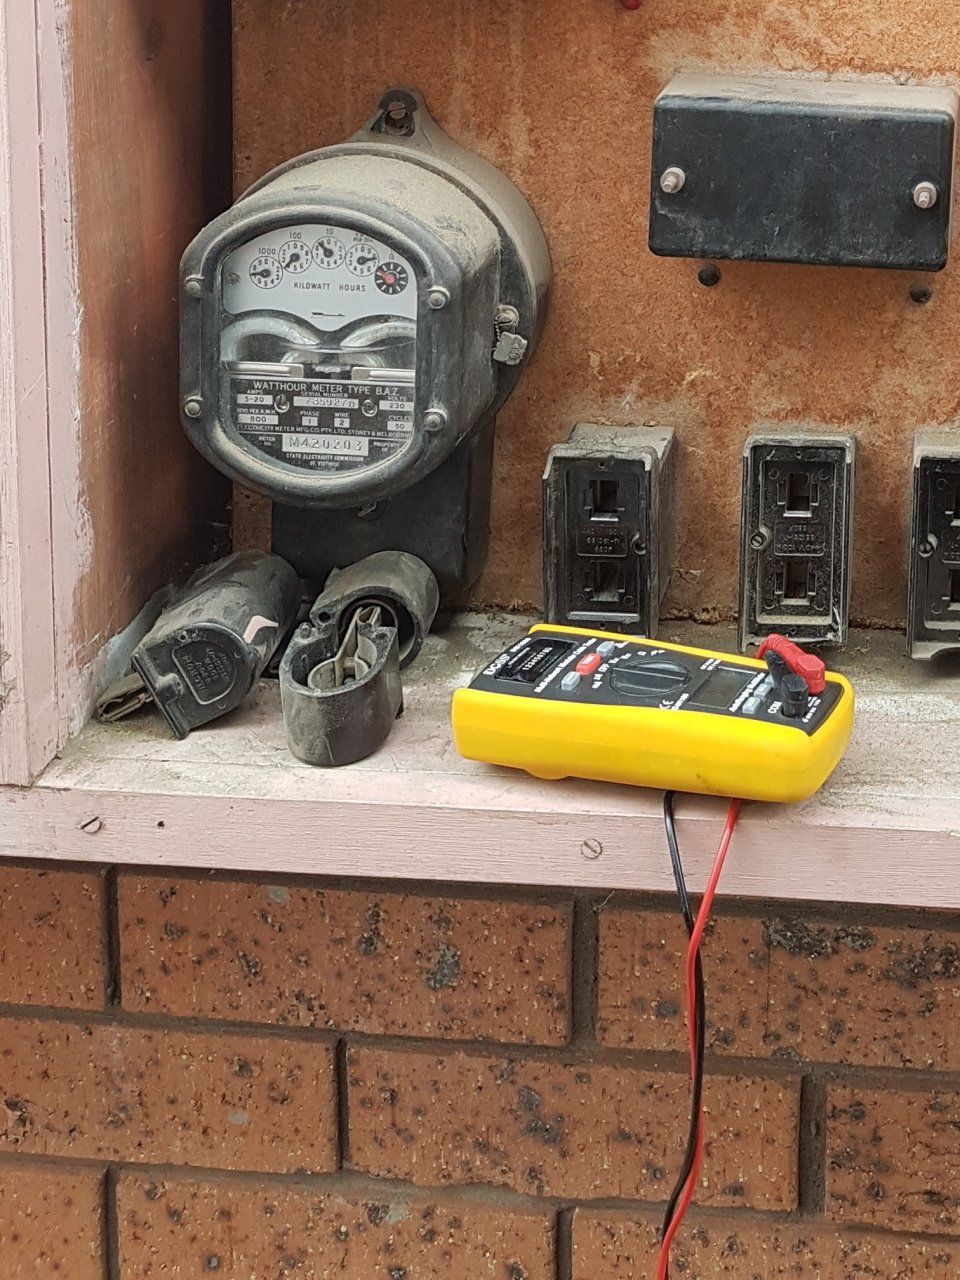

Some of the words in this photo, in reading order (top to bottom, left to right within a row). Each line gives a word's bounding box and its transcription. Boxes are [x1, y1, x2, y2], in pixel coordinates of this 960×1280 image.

[293, 281, 331, 290] KILOWATT
[339, 282, 366, 292] HOURS
[253, 381, 307, 391] WATTHOUR
[312, 384, 343, 392] METER
[347, 386, 371, 394] TYPE
[289, 436, 362, 451] M420203
